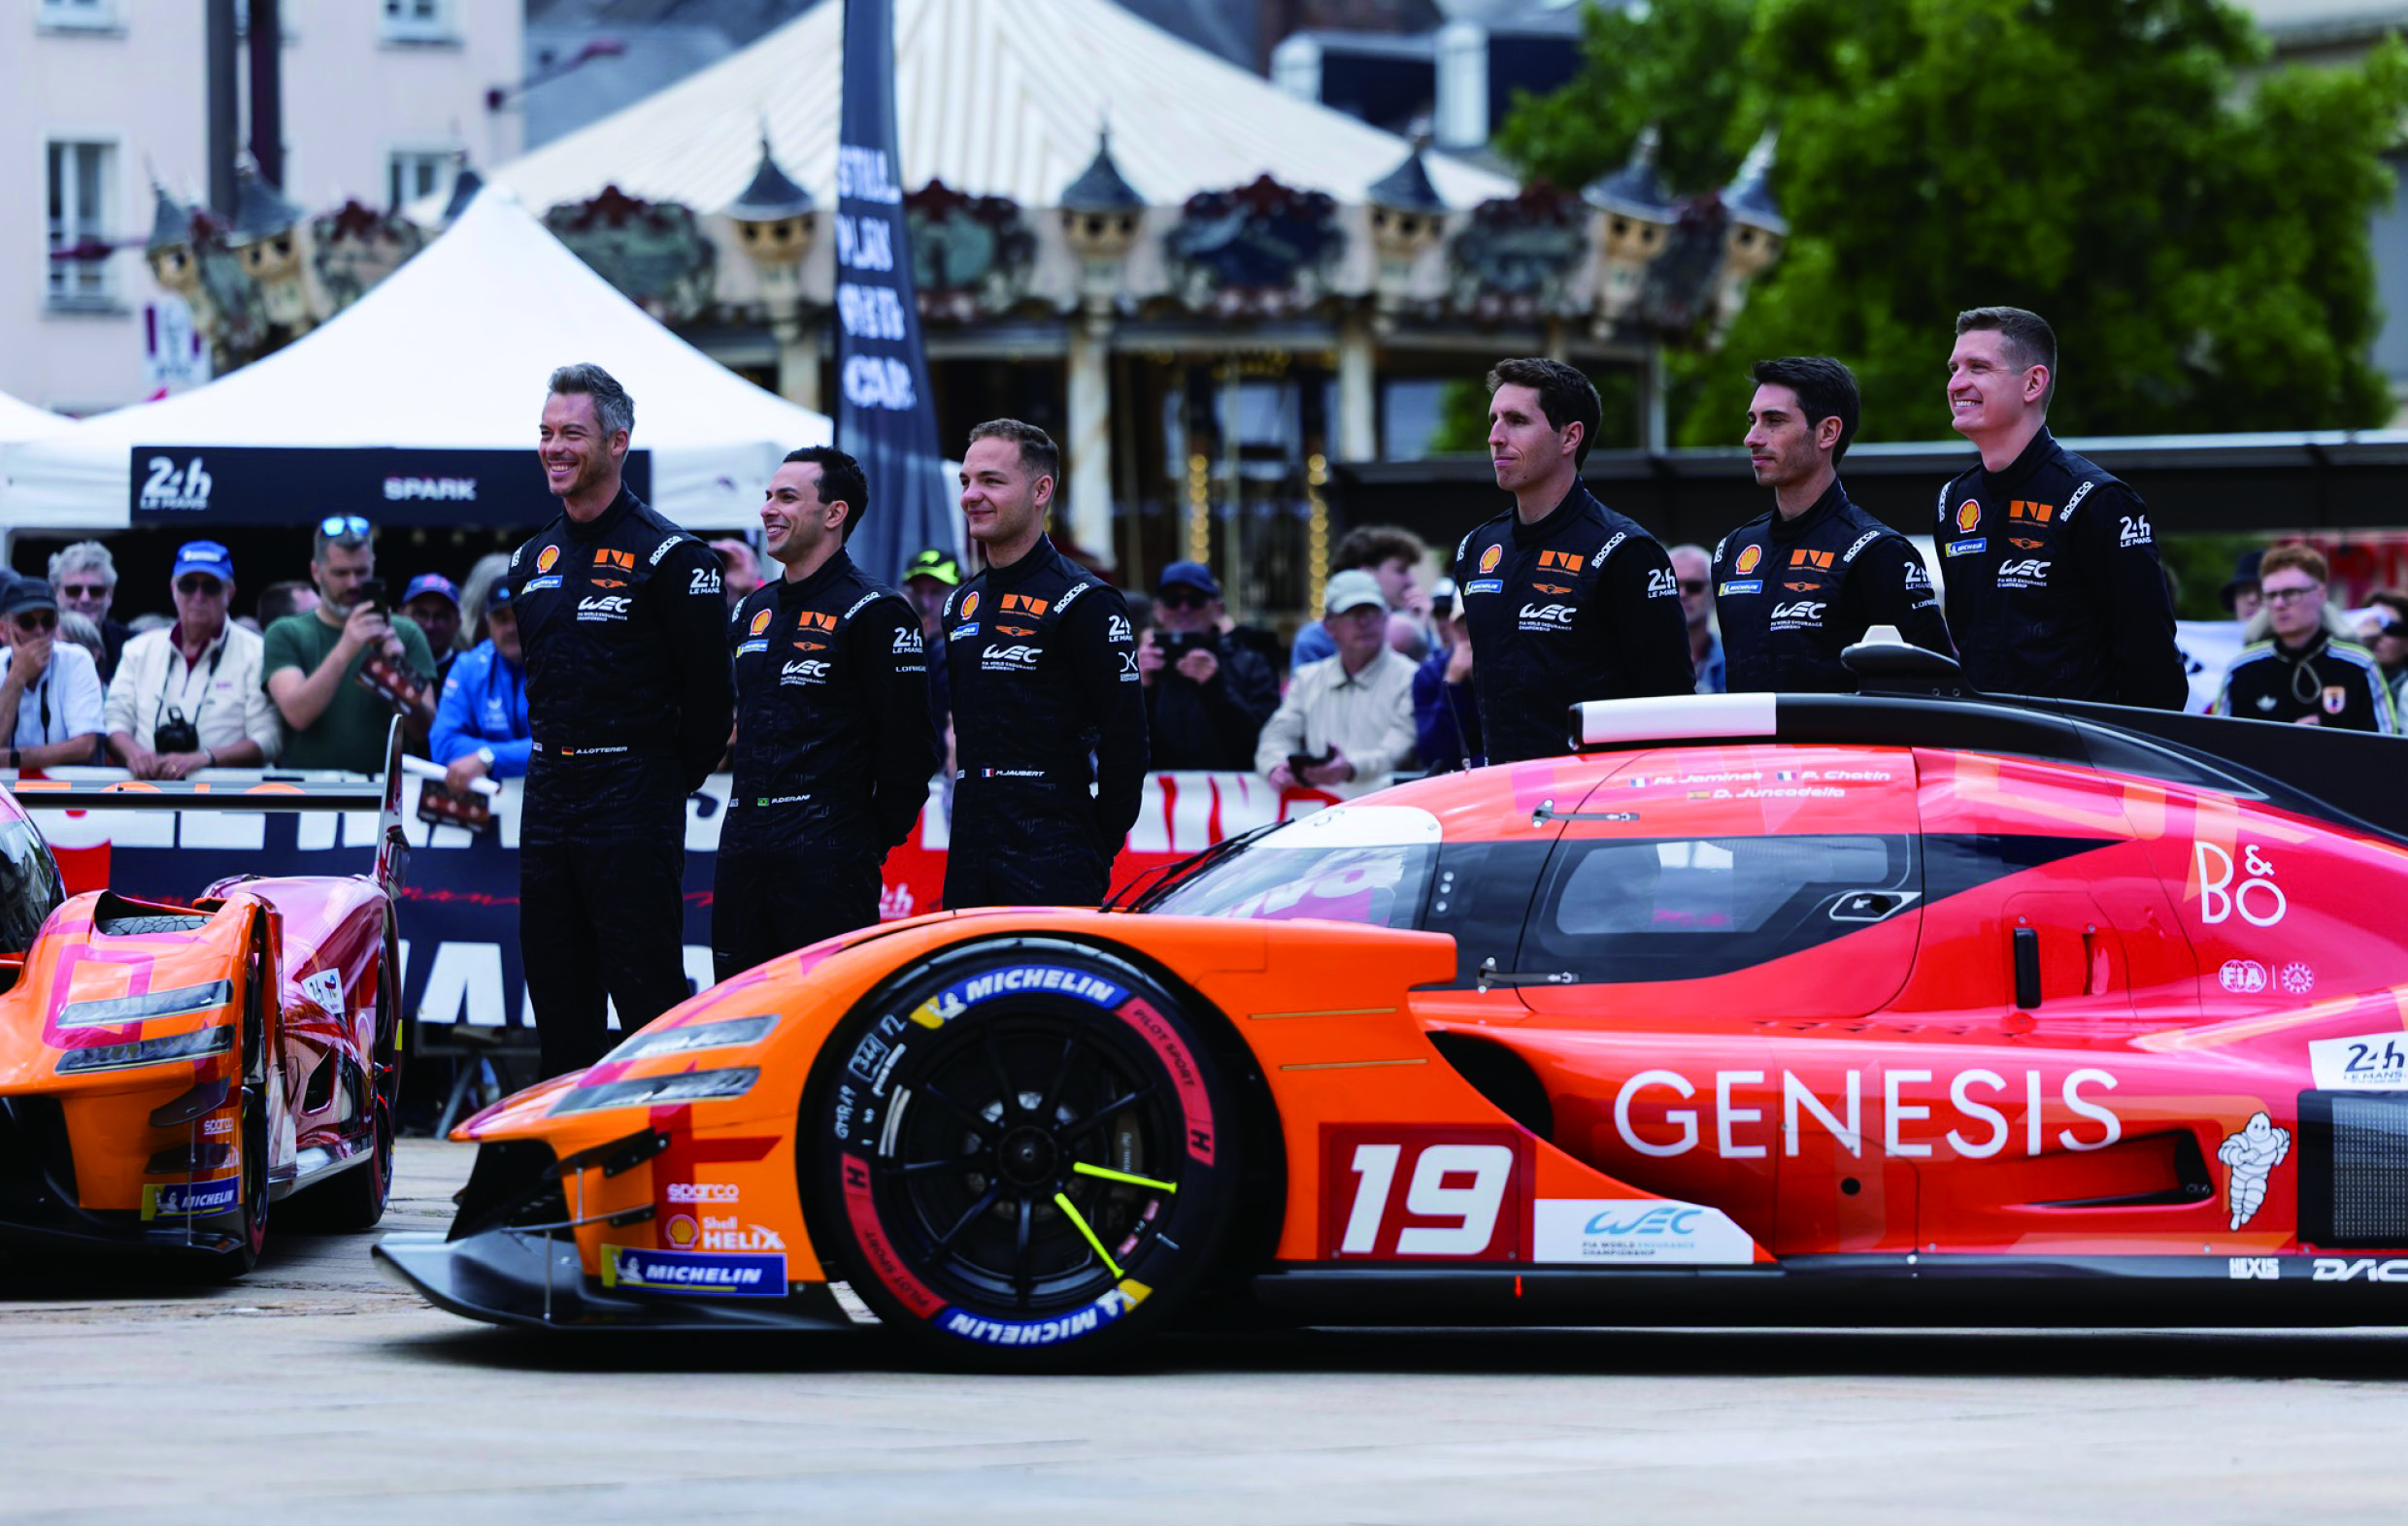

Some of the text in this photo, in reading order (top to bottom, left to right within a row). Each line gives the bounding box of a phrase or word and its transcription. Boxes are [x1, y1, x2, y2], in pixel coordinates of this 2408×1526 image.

[383, 477, 476, 501] SPARK
[2059, 481, 2094, 521] sparco
[2120, 514, 2151, 541] 24h
[1591, 532, 1626, 568] sparco
[2121, 539, 2131, 547] LE
[690, 568, 720, 587] 24h
[1998, 559, 2052, 578] WEC
[689, 586, 699, 595] LE
[1053, 582, 1088, 614] sparco
[578, 596, 632, 614] WEC
[1520, 603, 1577, 622] WEC
[1771, 601, 1826, 619] WEC
[893, 627, 922, 647] 24h
[983, 644, 1043, 663] WEC
[782, 660, 831, 677] WEC
[1714, 788, 1733, 798] D.
[965, 969, 1116, 1003] MICHELIN
[1133, 1008, 1196, 1087] PILOT SPORT
[2345, 1040, 2405, 1073] 24h
[1614, 1068, 2123, 1159] GENESIS
[1190, 1129, 1212, 1153] H
[847, 1164, 867, 1188] H
[181, 1189, 234, 1209] MICHELIN
[666, 1183, 739, 1203] sparco
[1340, 1144, 1515, 1256] 19
[702, 1216, 738, 1230] Shell
[1584, 1207, 1703, 1235] WEC
[702, 1224, 786, 1250] HELIX
[646, 1264, 763, 1284] MICHELIN
[948, 1308, 1098, 1344] MICHELIN
